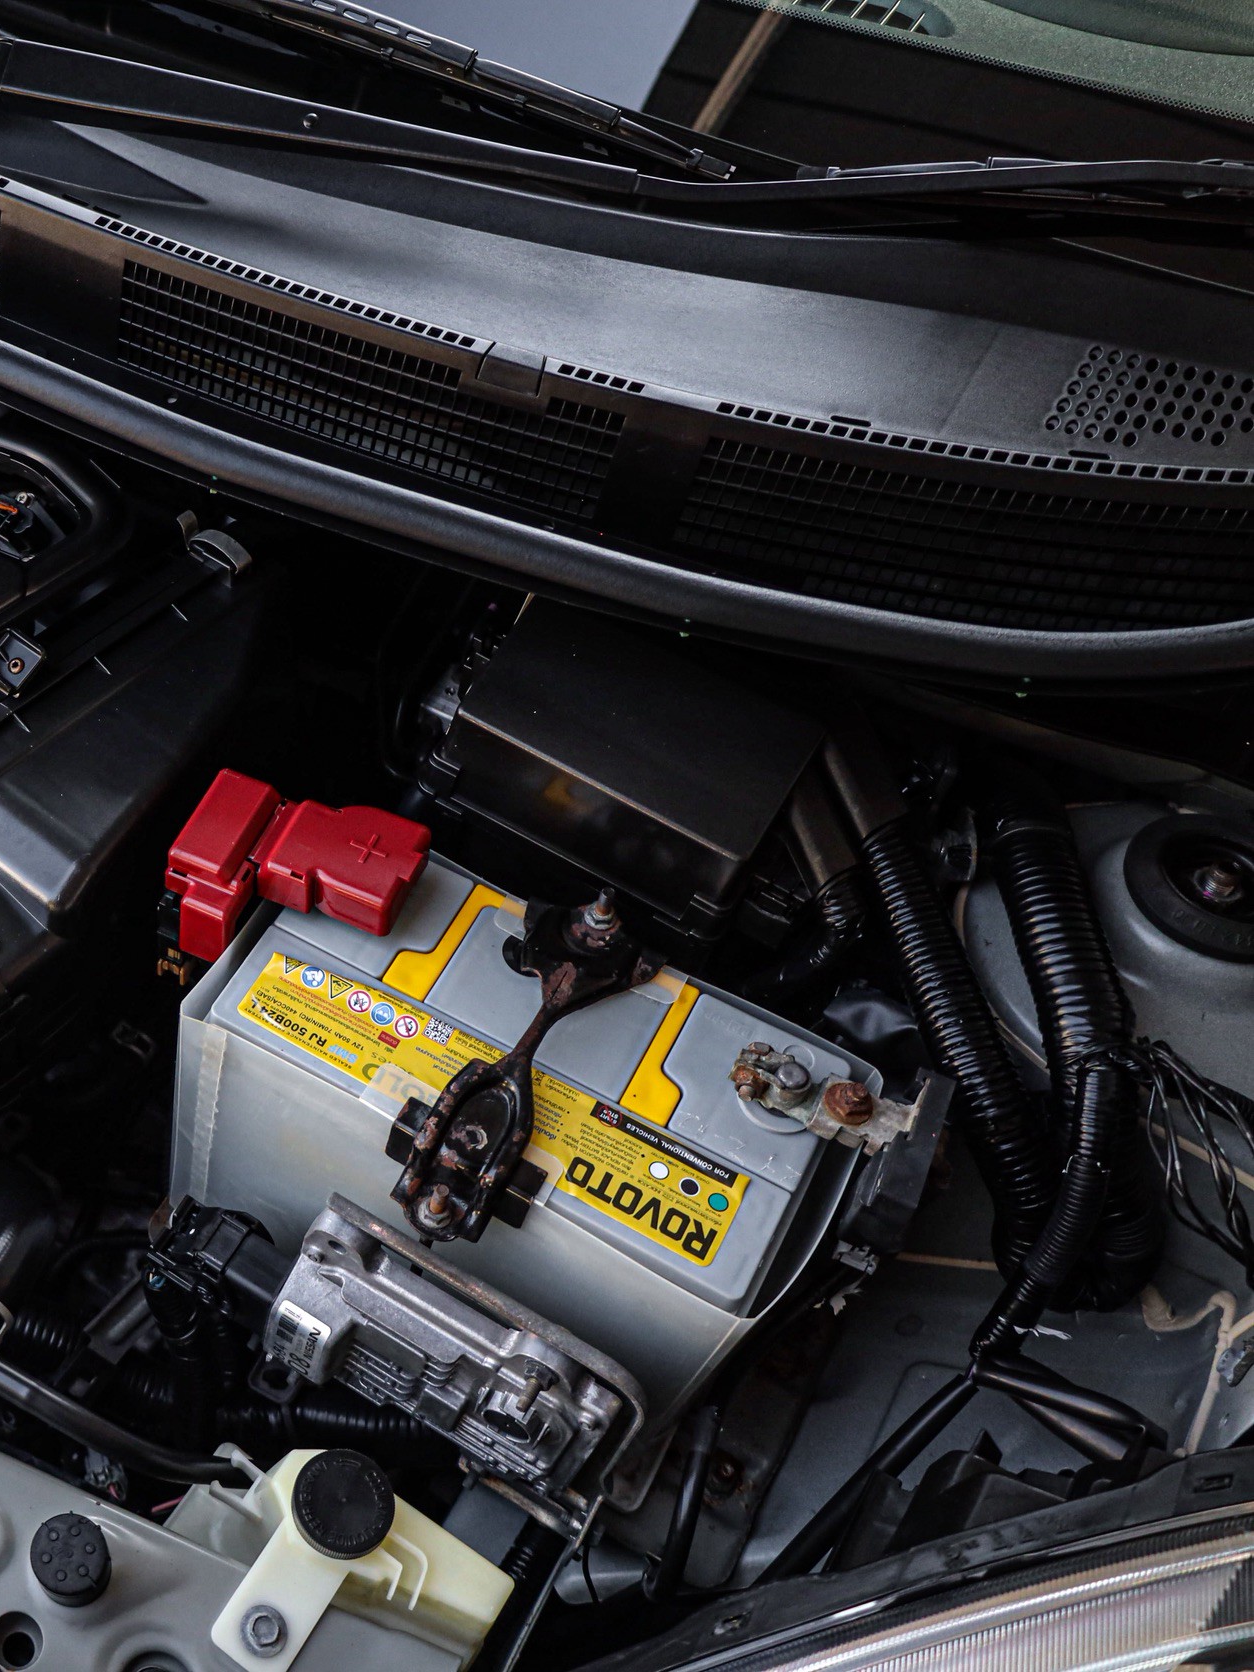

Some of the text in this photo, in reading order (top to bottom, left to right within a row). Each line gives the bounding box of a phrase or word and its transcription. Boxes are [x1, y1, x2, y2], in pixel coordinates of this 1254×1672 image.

[248, 999, 327, 1046] RJ 500B24 L
[256, 988, 364, 1050] 12V 50Ah 70MIN(RC) 440CCA(SAE)
[286, 1030, 327, 1055] MAINTENANCE
[328, 1054, 351, 1069] SEALED
[359, 1059, 438, 1107] OLD
[625, 1122, 659, 1143] VEHICLES
[578, 1147, 605, 1163] INDICATOR
[579, 1141, 600, 1154] BATTERY
[599, 1151, 620, 1165] REPLACE
[659, 1138, 713, 1171] CONVENTIONAL
[713, 1166, 729, 1179] FOR
[565, 1156, 718, 1259] ROVOTO
[303, 1326, 322, 1361] NISSAN
